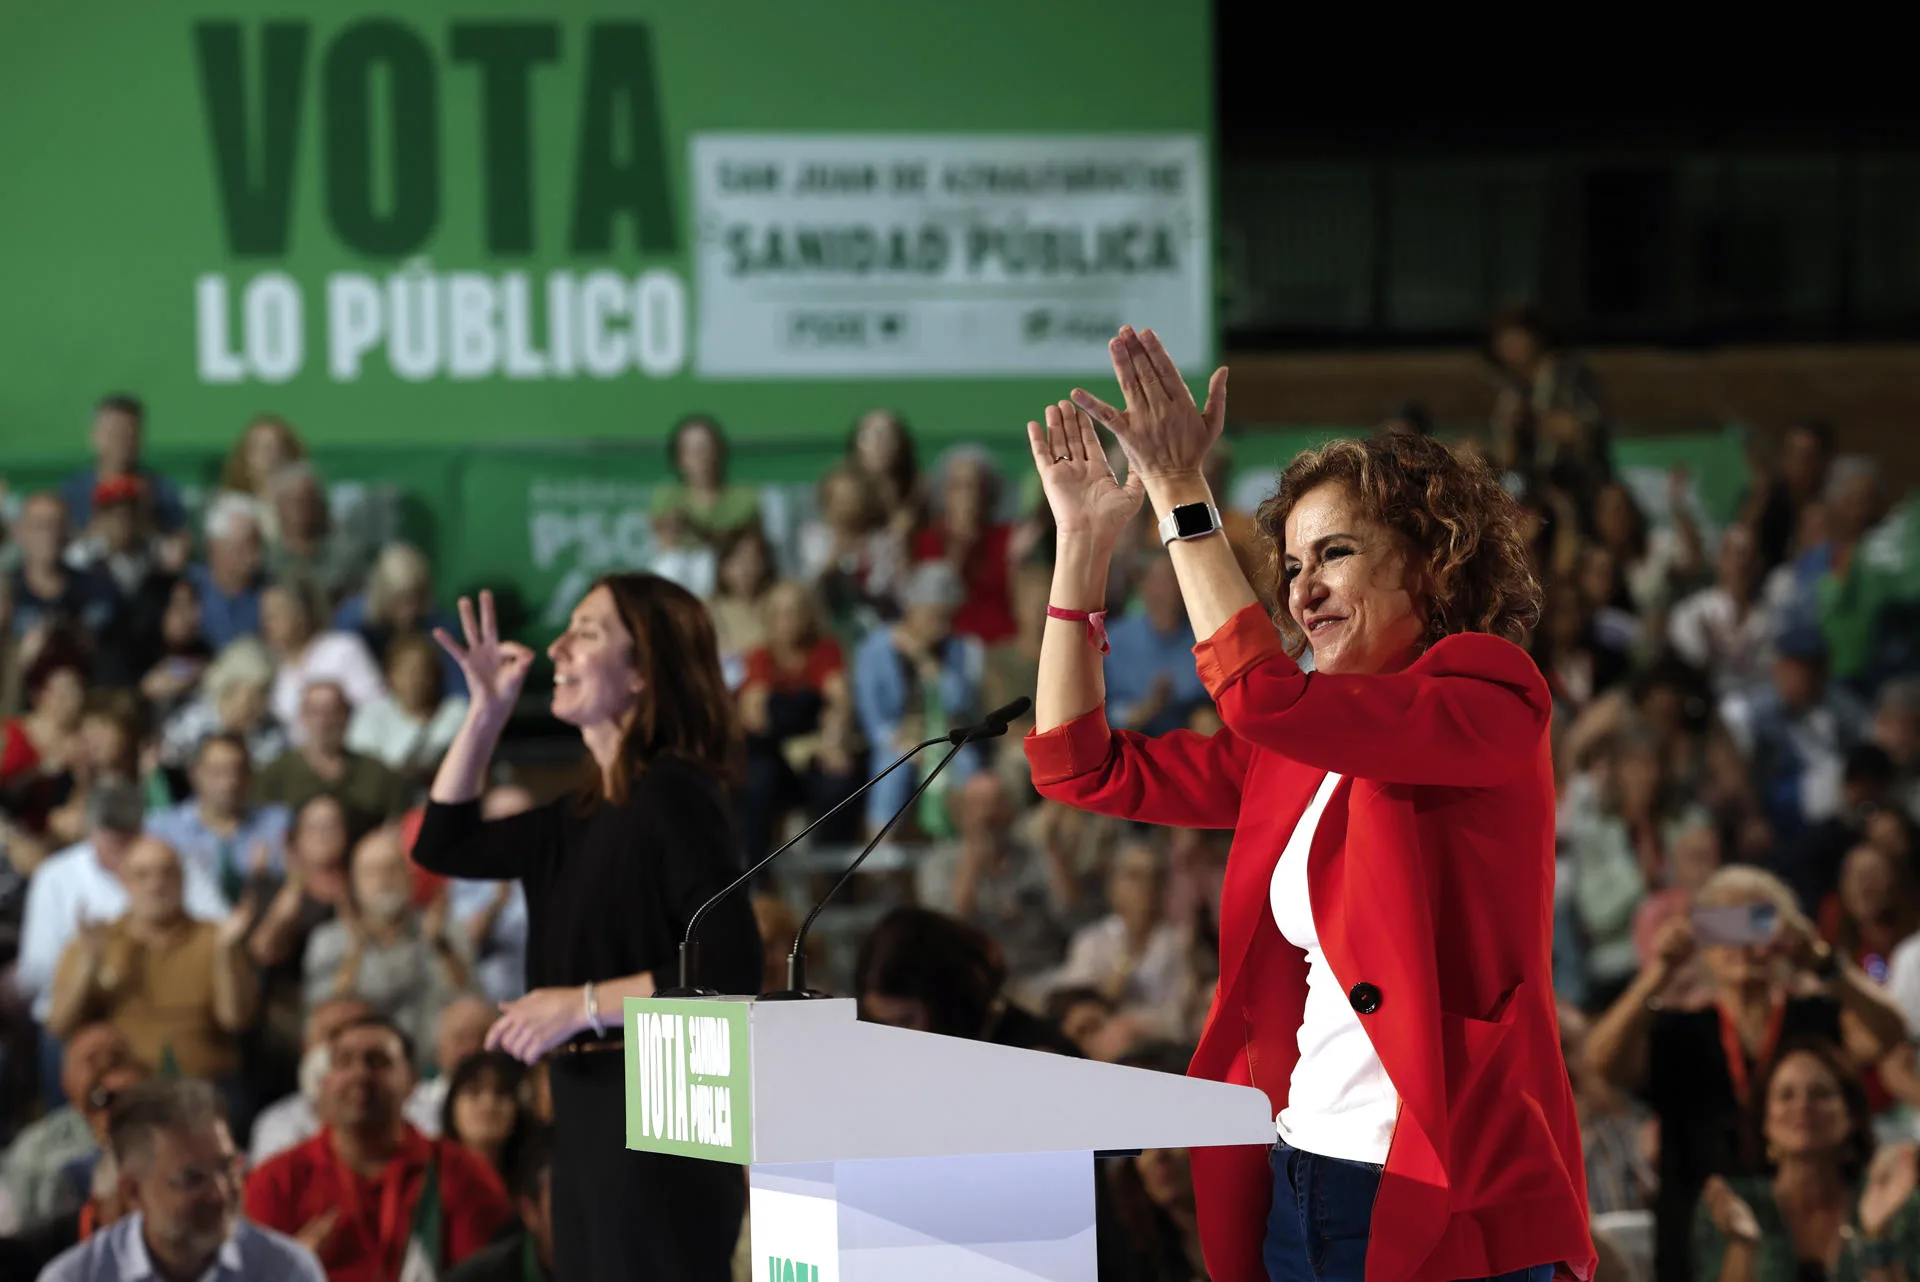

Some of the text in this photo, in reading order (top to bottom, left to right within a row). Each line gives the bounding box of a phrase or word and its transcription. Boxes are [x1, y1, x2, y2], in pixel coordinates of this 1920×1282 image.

[193, 19, 681, 259] VOTA
[795, 159, 880, 193] JUAN
[890, 159, 928, 192] DE
[724, 205, 1179, 277] SANIDAD PÚBLICA
[197, 255, 685, 382] LO PÚBLICO
[637, 1012, 689, 1142] VOTA
[688, 1015, 731, 1077] SANIDAD
[690, 1076, 733, 1147] PÚBLICA
